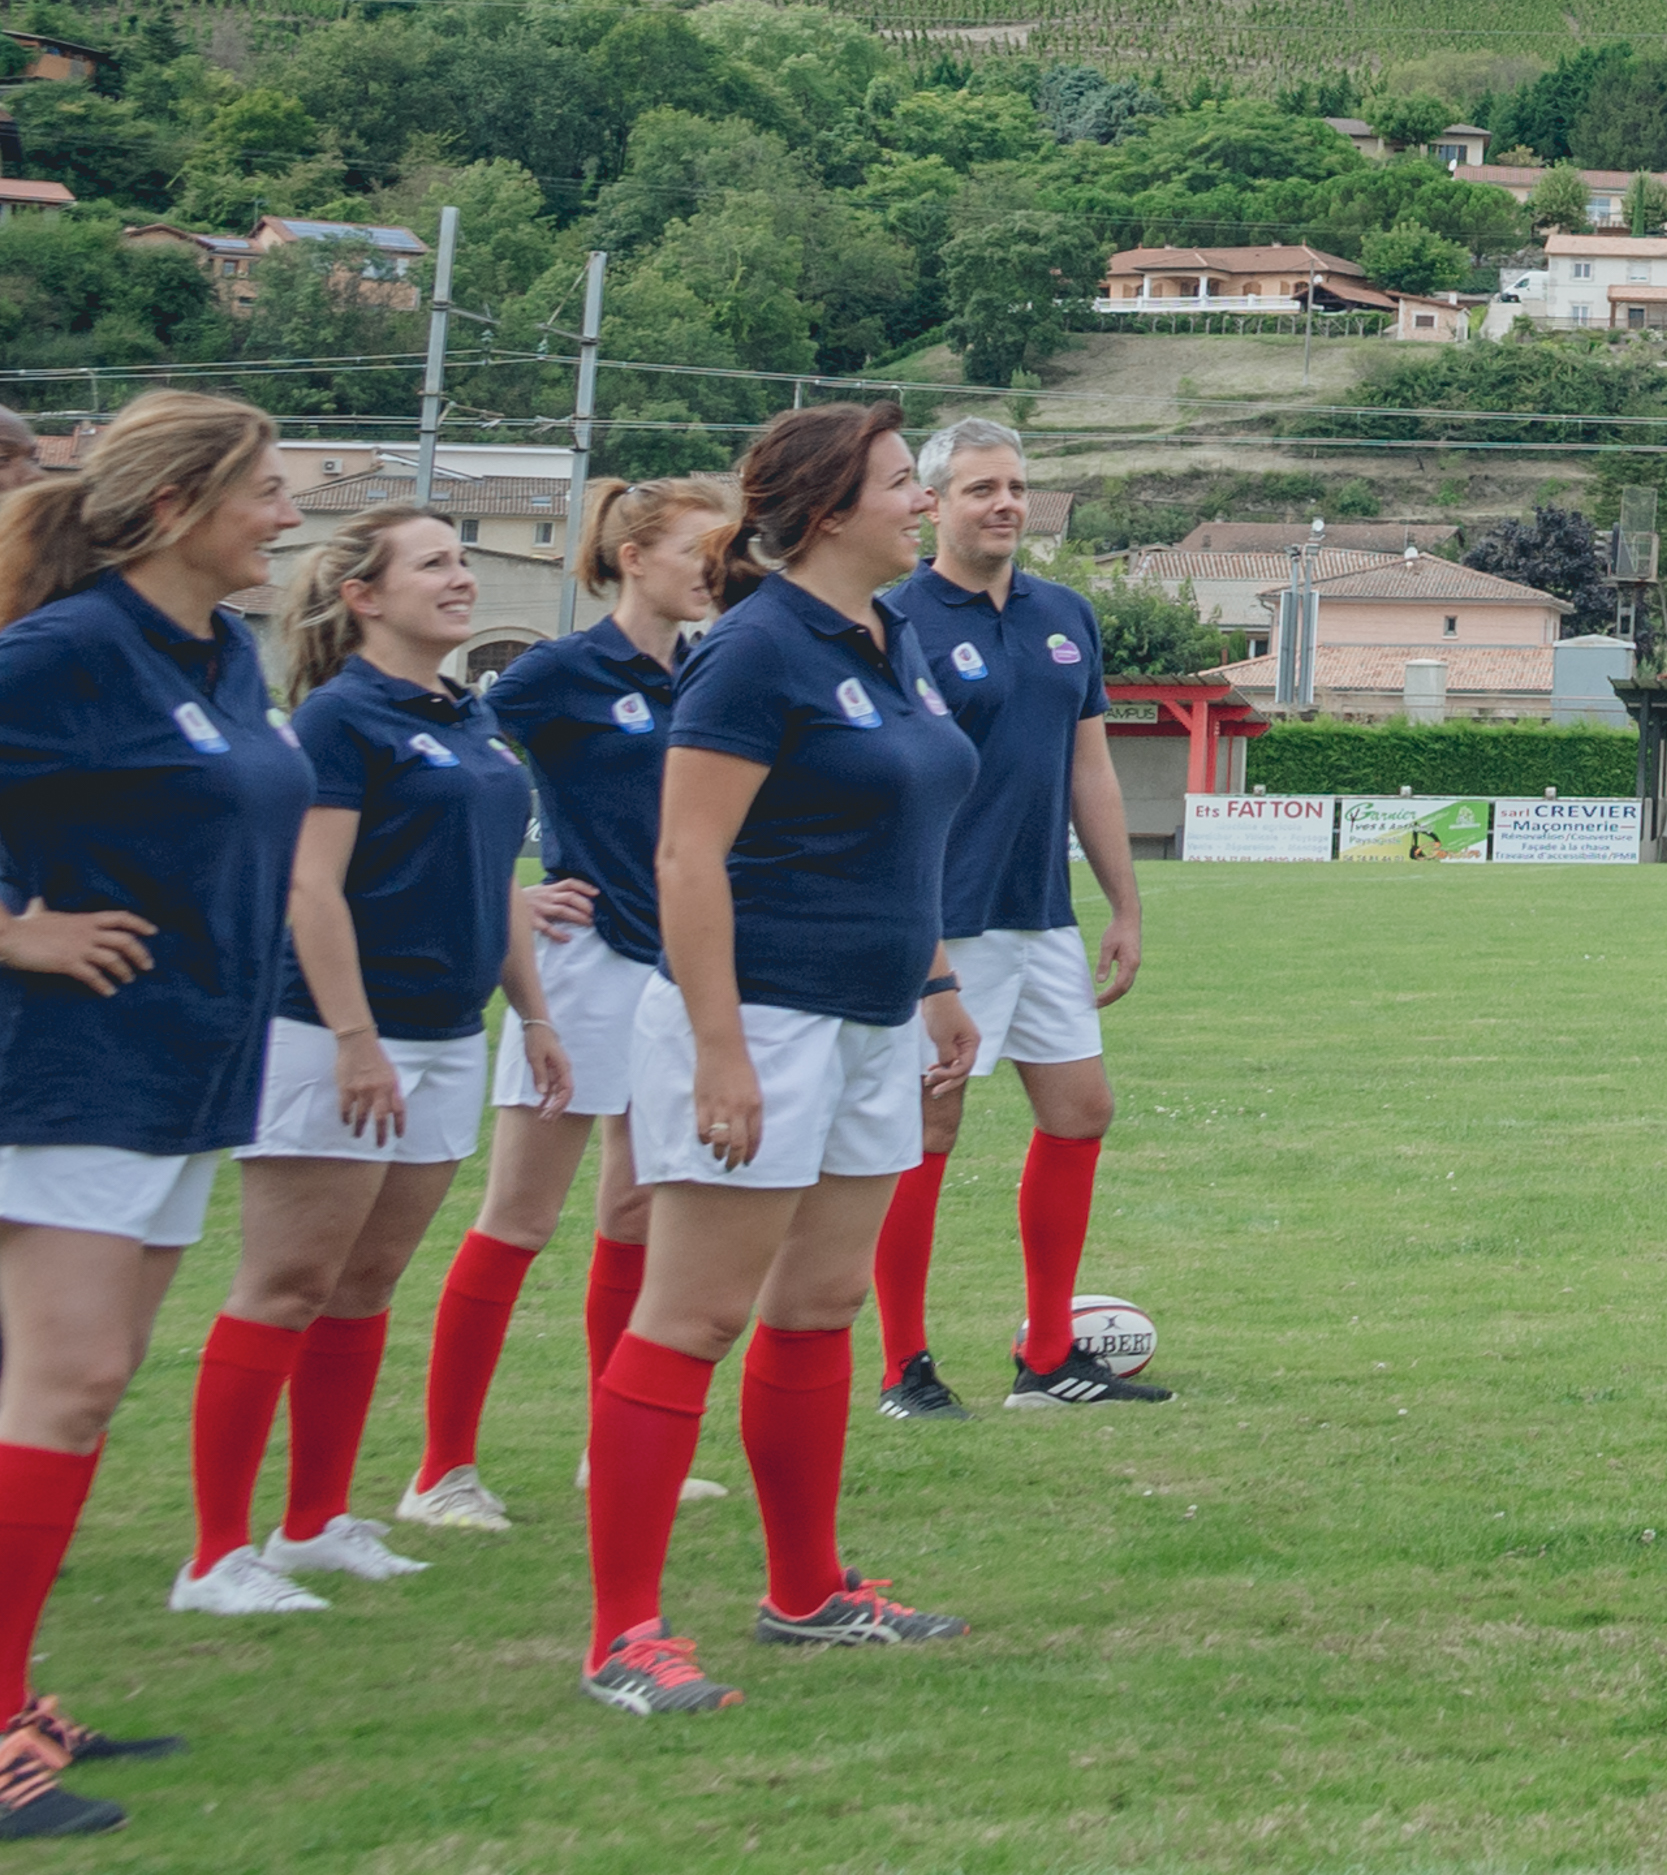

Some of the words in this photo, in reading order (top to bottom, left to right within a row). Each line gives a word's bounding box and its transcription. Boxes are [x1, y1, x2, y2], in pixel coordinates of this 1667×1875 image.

[1195, 805, 1220, 818] Ets
[1227, 800, 1323, 819] FATTON
[1500, 808, 1530, 818] sarl
[1534, 805, 1637, 819] CREVIER
[1513, 820, 1619, 833] Maçonnerie
